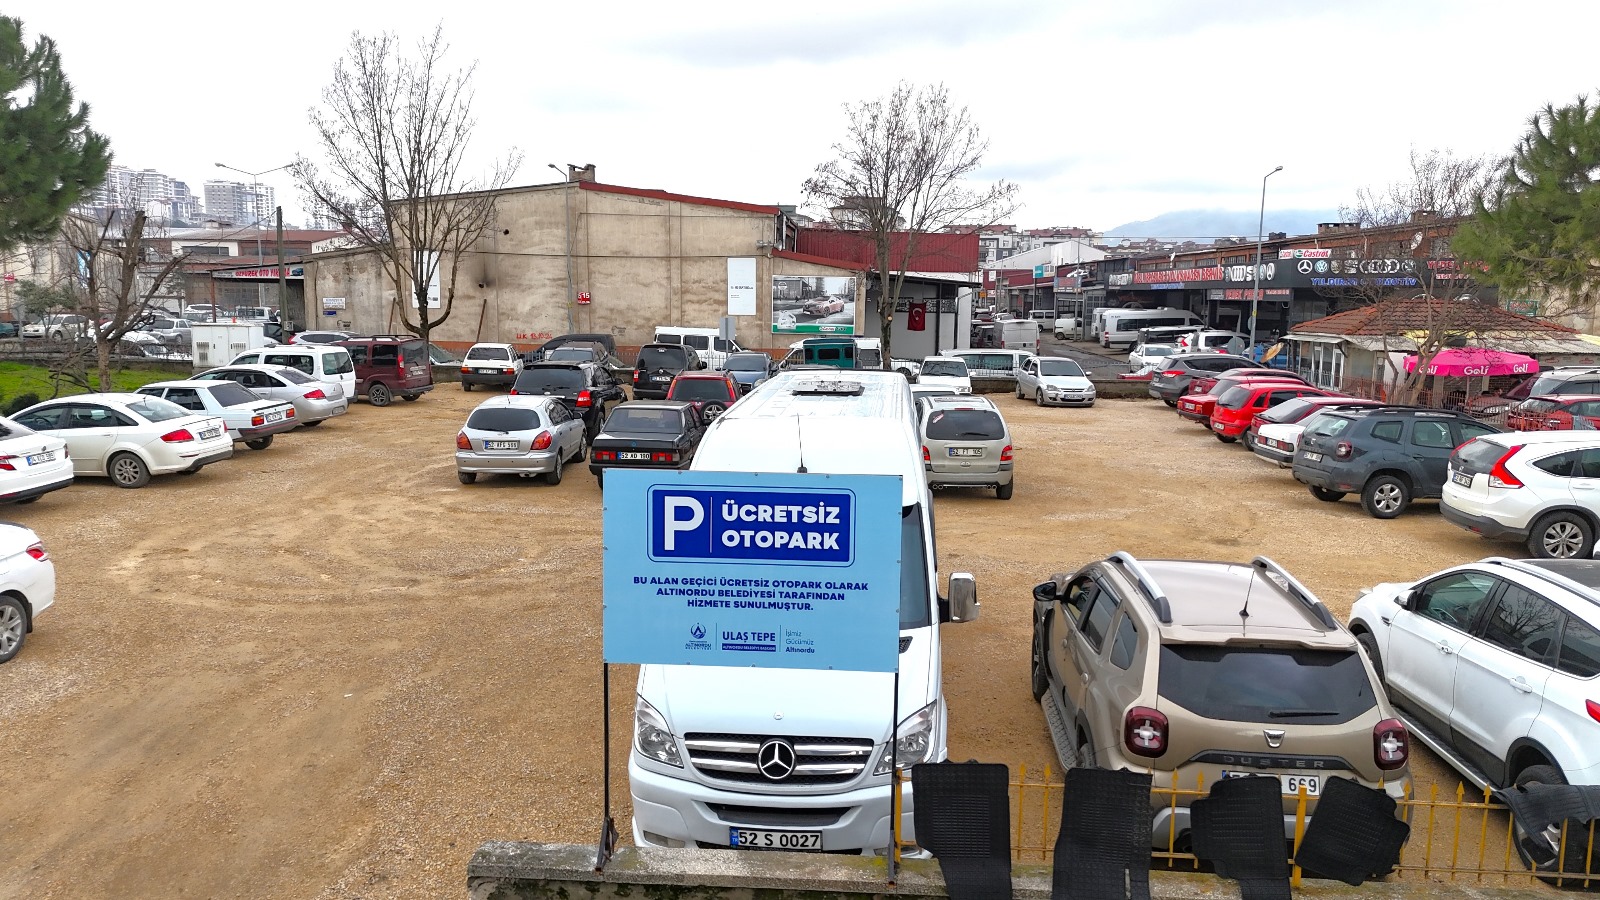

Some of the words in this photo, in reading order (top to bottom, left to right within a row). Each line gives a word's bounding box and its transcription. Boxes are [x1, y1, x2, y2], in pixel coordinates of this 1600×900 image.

[1303, 250, 1329, 258] Castrol
[1464, 366, 1489, 375] Golf
[1514, 364, 1528, 373] Golf
[721, 499, 840, 524] ÜCRETSİZ
[664, 495, 704, 551] P
[721, 530, 839, 550] OTOPARK
[633, 576, 647, 585] BU
[650, 576, 678, 585] ALAN
[681, 576, 717, 588] GEÇİCİ
[720, 577, 770, 588] ÜCRETSİZ
[772, 580, 822, 589] OTOPARK
[825, 581, 869, 590] OLARAK
[656, 588, 715, 597] ALTINORDU
[718, 588, 775, 598] BELEDİYESİ
[779, 592, 845, 601] TARAFINDAN
[687, 598, 730, 608] HİZMETE
[734, 601, 813, 612] SUNULMUŞTUR.
[722, 631, 748, 642] ULAŞ
[751, 632, 775, 641] TEPE
[1223, 755, 1324, 768] DUSTER
[739, 832, 758, 846] 52
[764, 834, 773, 846] S
[780, 834, 819, 847] 0027
